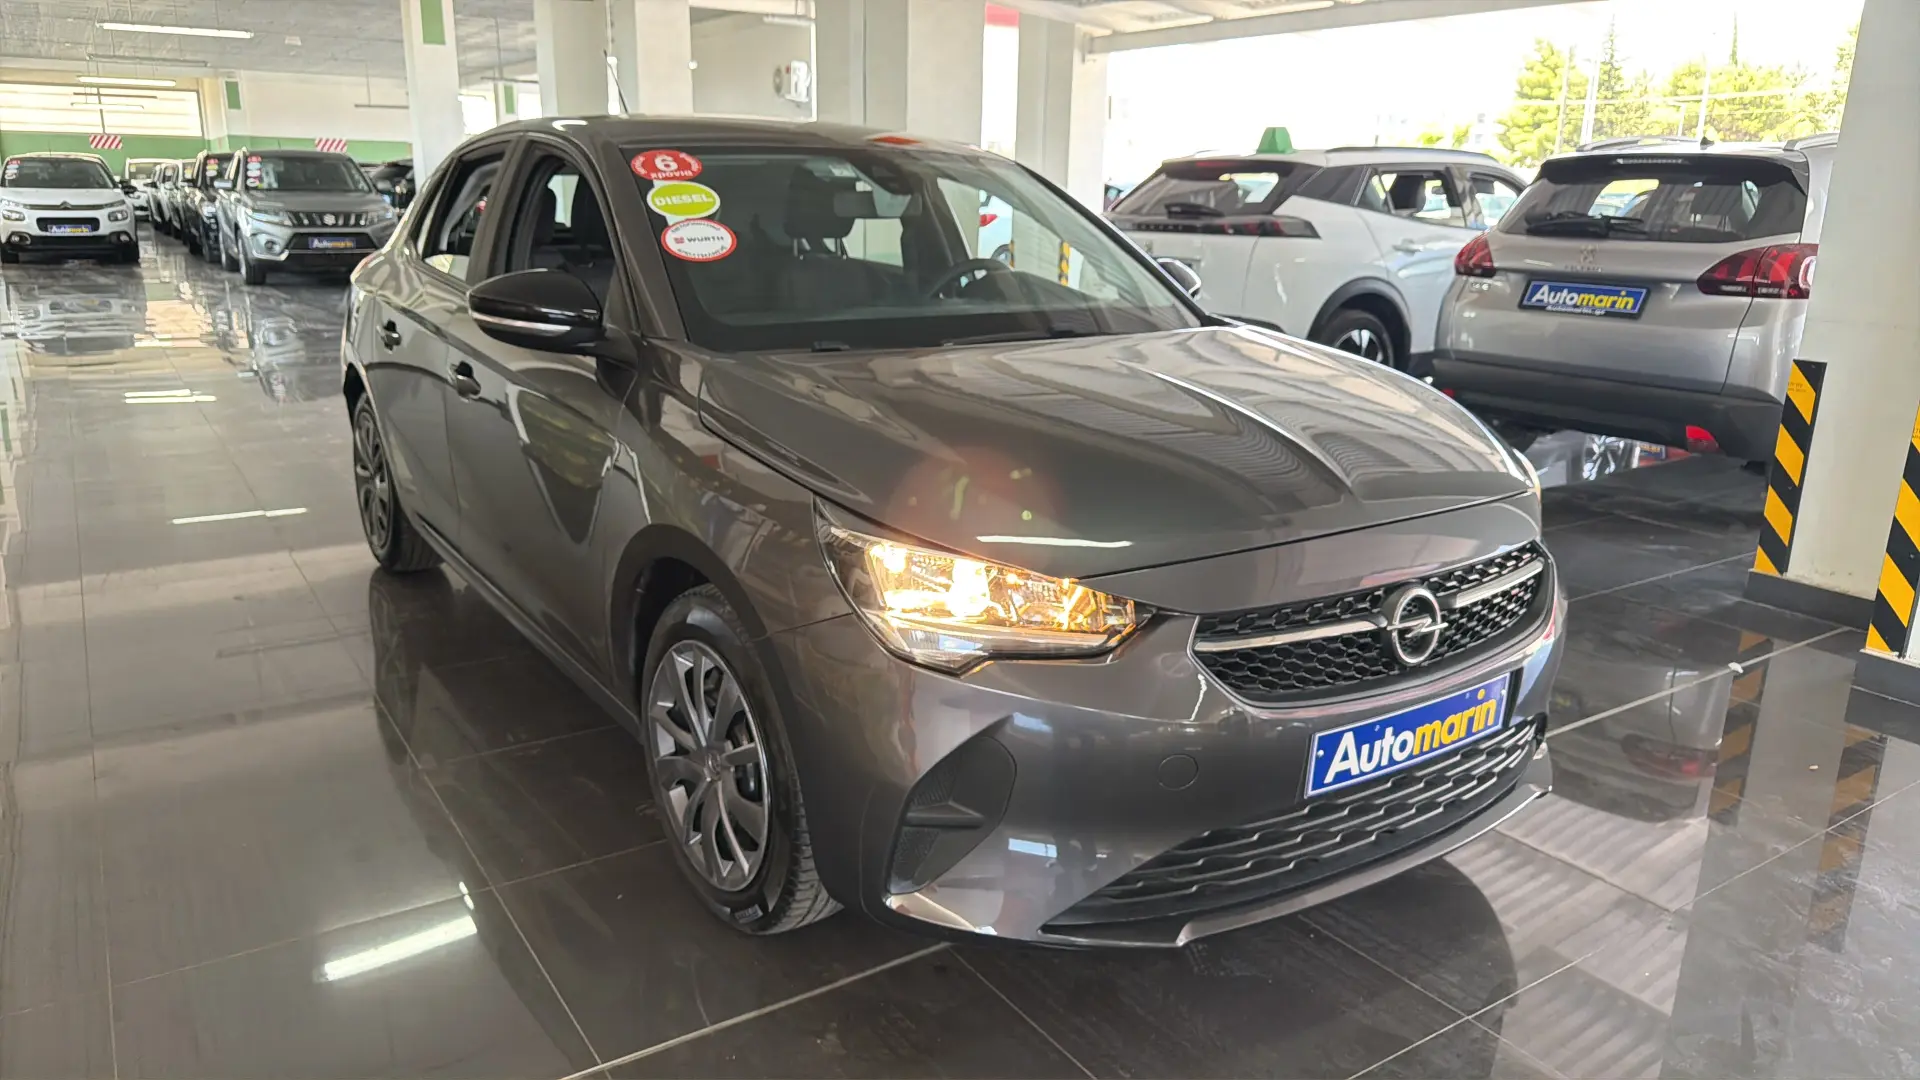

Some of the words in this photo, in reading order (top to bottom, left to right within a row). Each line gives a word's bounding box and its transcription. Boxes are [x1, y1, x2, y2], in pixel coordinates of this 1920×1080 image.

[655, 194, 714, 206] DIESEL
[1531, 284, 1634, 310] Automarin
[1324, 689, 1497, 784] Automarin
